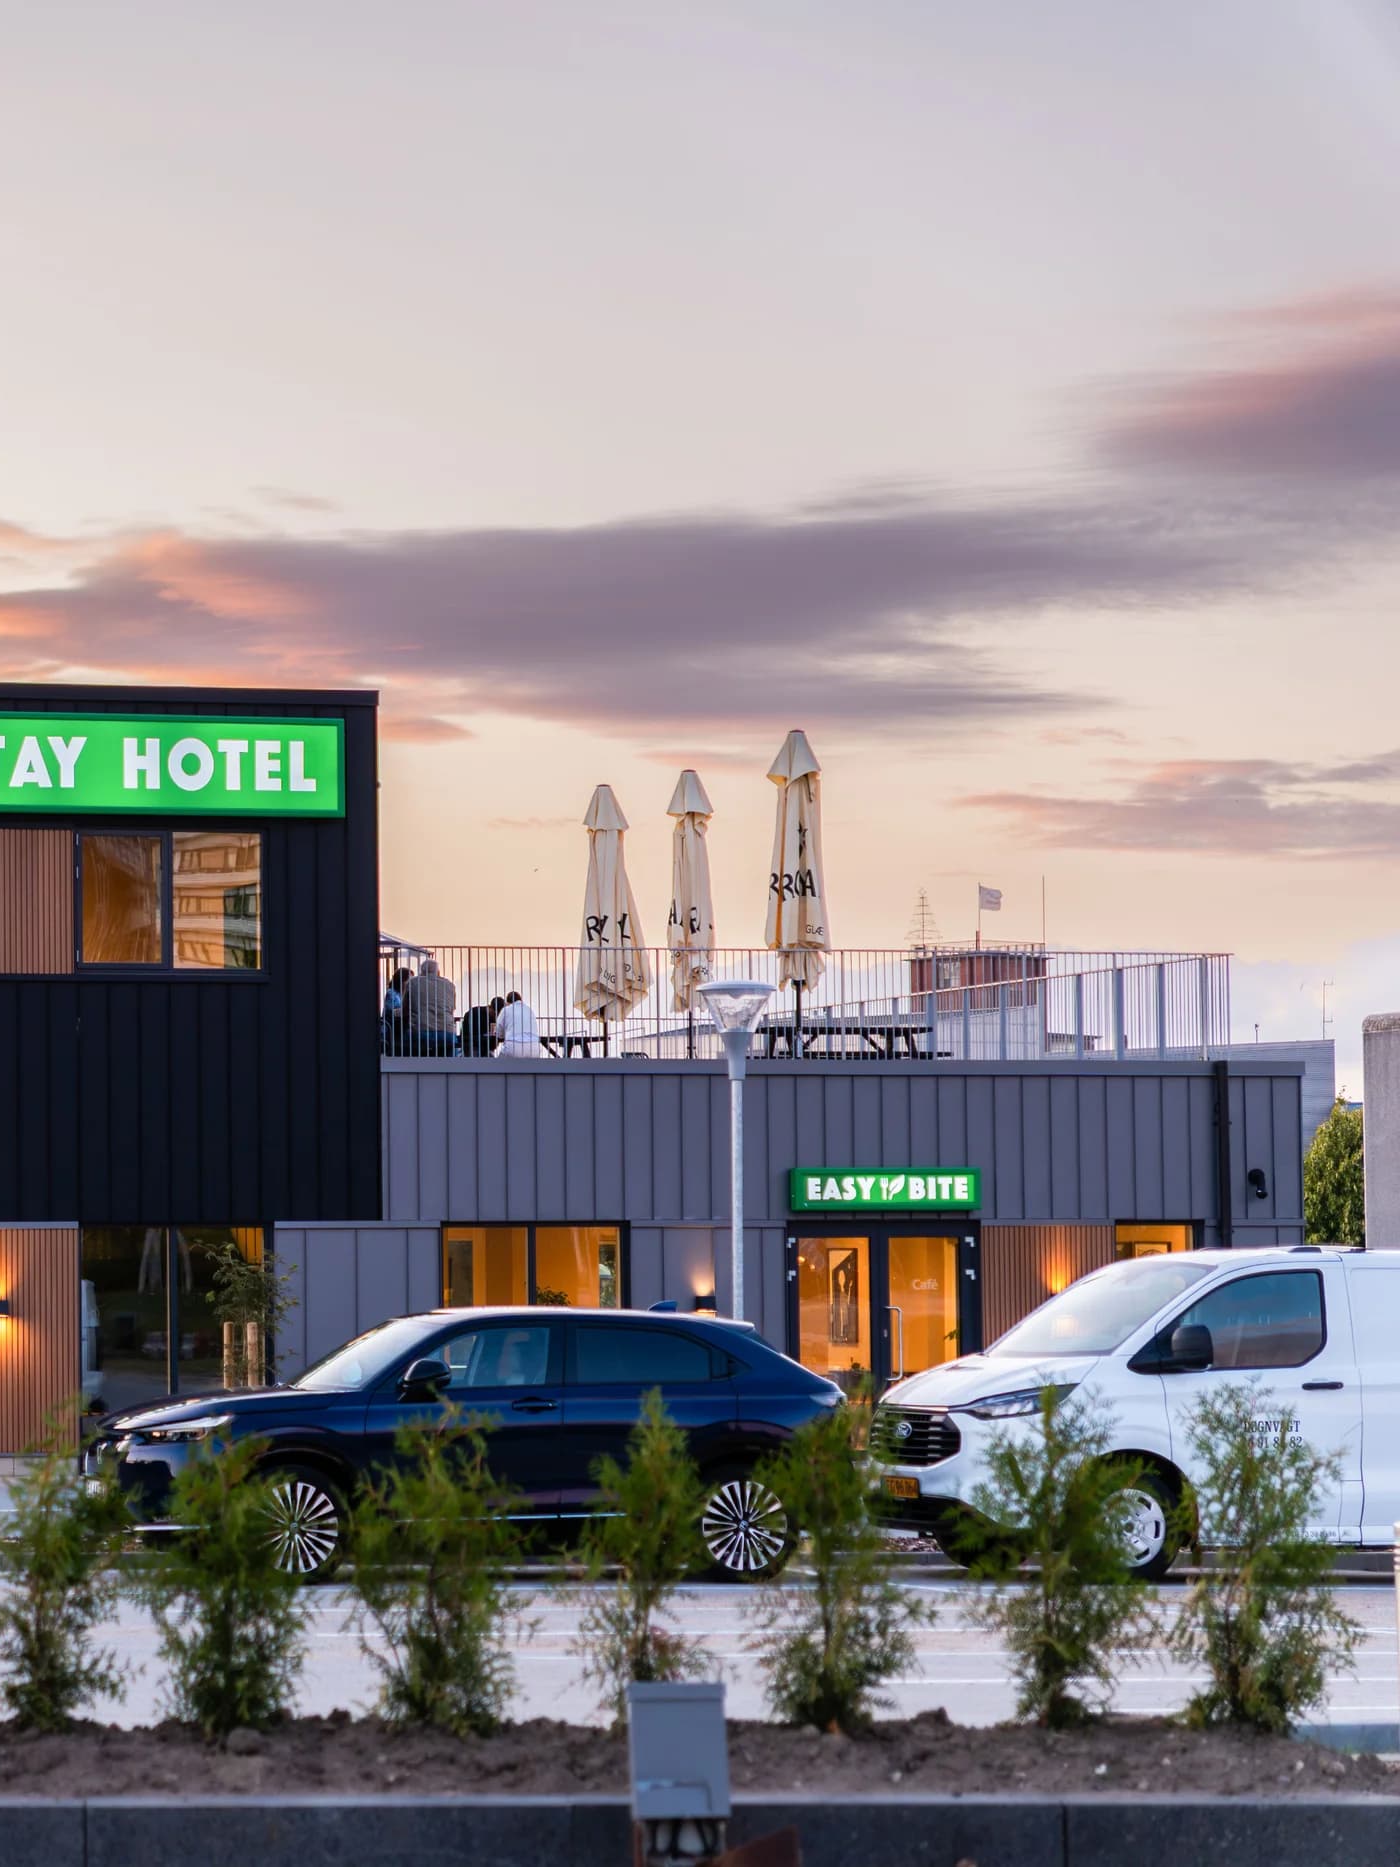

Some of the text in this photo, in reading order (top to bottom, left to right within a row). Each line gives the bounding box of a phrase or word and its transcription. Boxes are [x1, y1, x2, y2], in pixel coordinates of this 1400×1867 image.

[122, 737, 316, 793] HOTEL
[807, 1177, 969, 1200] EASY BITE
[912, 1278, 939, 1291] Café
